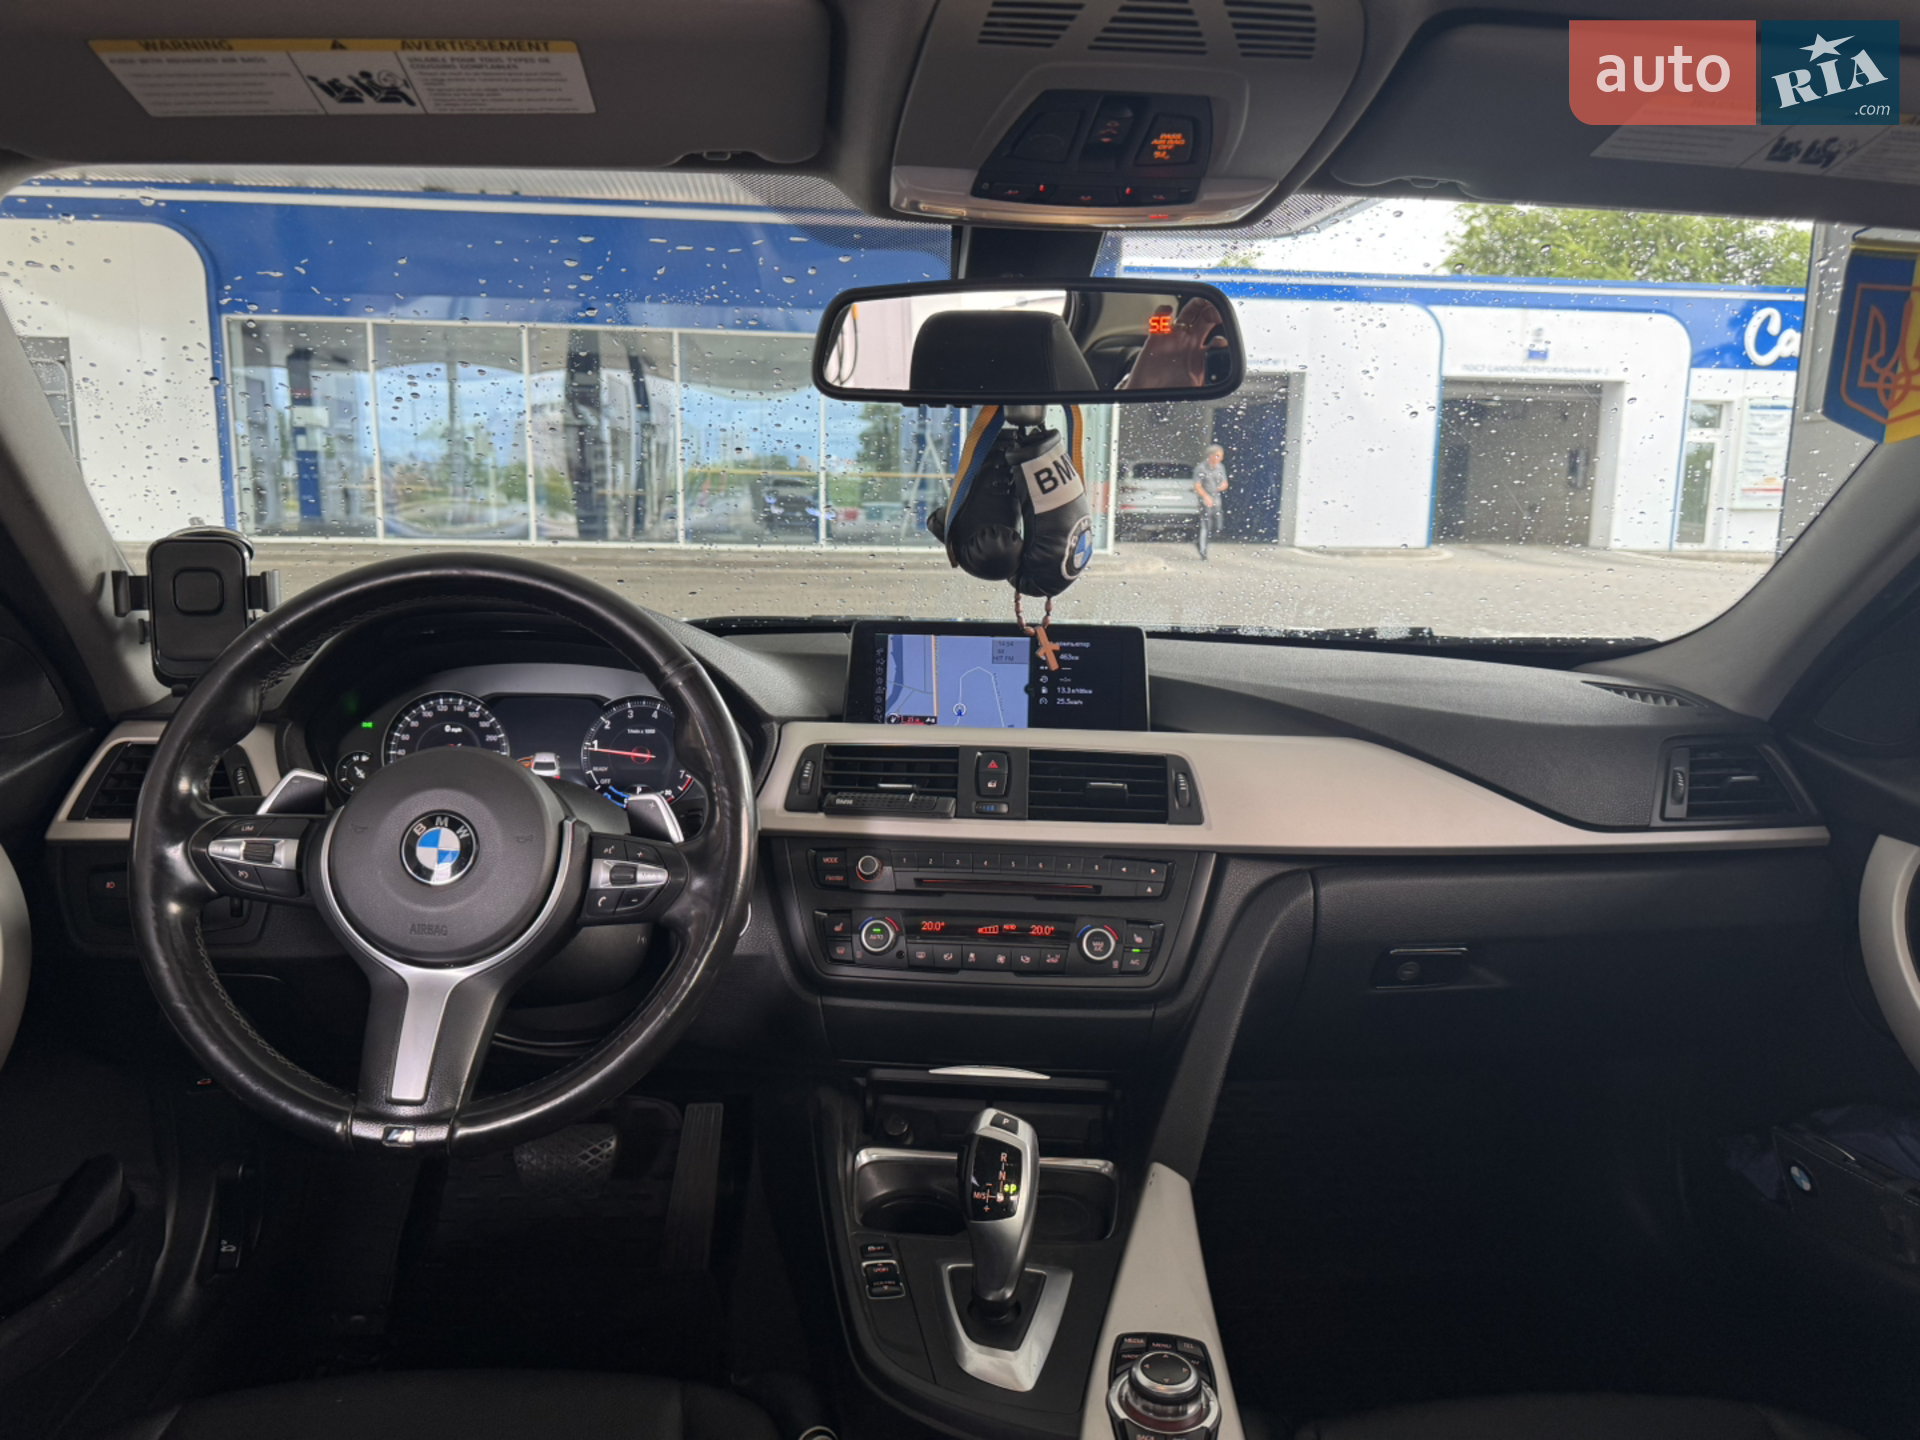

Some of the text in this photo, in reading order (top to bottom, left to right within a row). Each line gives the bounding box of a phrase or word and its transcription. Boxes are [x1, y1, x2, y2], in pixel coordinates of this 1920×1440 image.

[136, 39, 234, 51] WARNING
[401, 39, 551, 52] AVERTISSEMENT
[1149, 316, 1172, 333] SE
[1033, 452, 1076, 495] BM
[627, 709, 635, 719] 3
[651, 709, 660, 719] 4
[444, 724, 451, 733] 0
[604, 719, 612, 730] 2
[679, 769, 686, 779] 7
[412, 815, 470, 839] BMW
[409, 923, 448, 936] AIRBAG
[1002, 1117, 1009, 1125] P
[1000, 1152, 1008, 1163] R
[999, 1171, 1007, 1181] N
